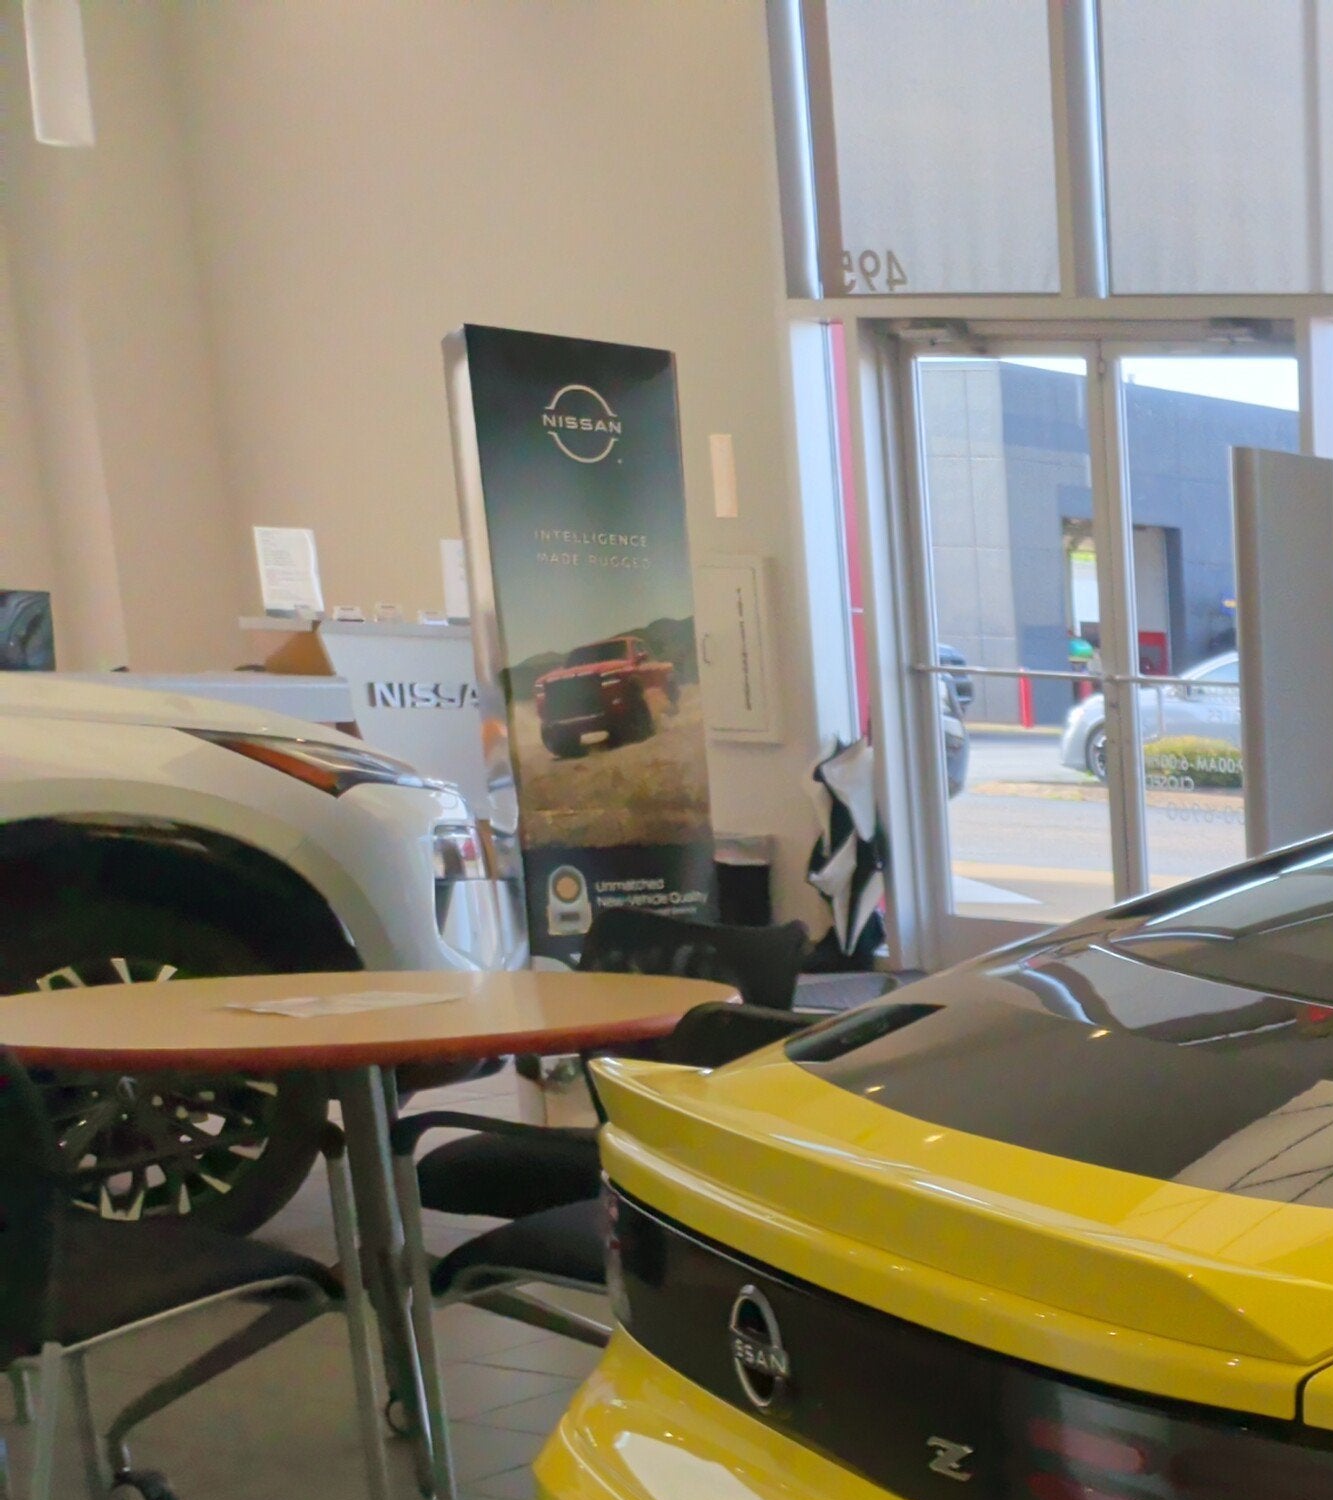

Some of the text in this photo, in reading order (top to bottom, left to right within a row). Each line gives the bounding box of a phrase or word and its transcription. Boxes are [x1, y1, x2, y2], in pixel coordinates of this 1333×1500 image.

[542, 413, 622, 434] NISSAN
[535, 529, 648, 548] INTELLIGENCE
[537, 553, 579, 567] MADE
[366, 681, 480, 709] NISSA
[926, 1435, 974, 1482] Z
